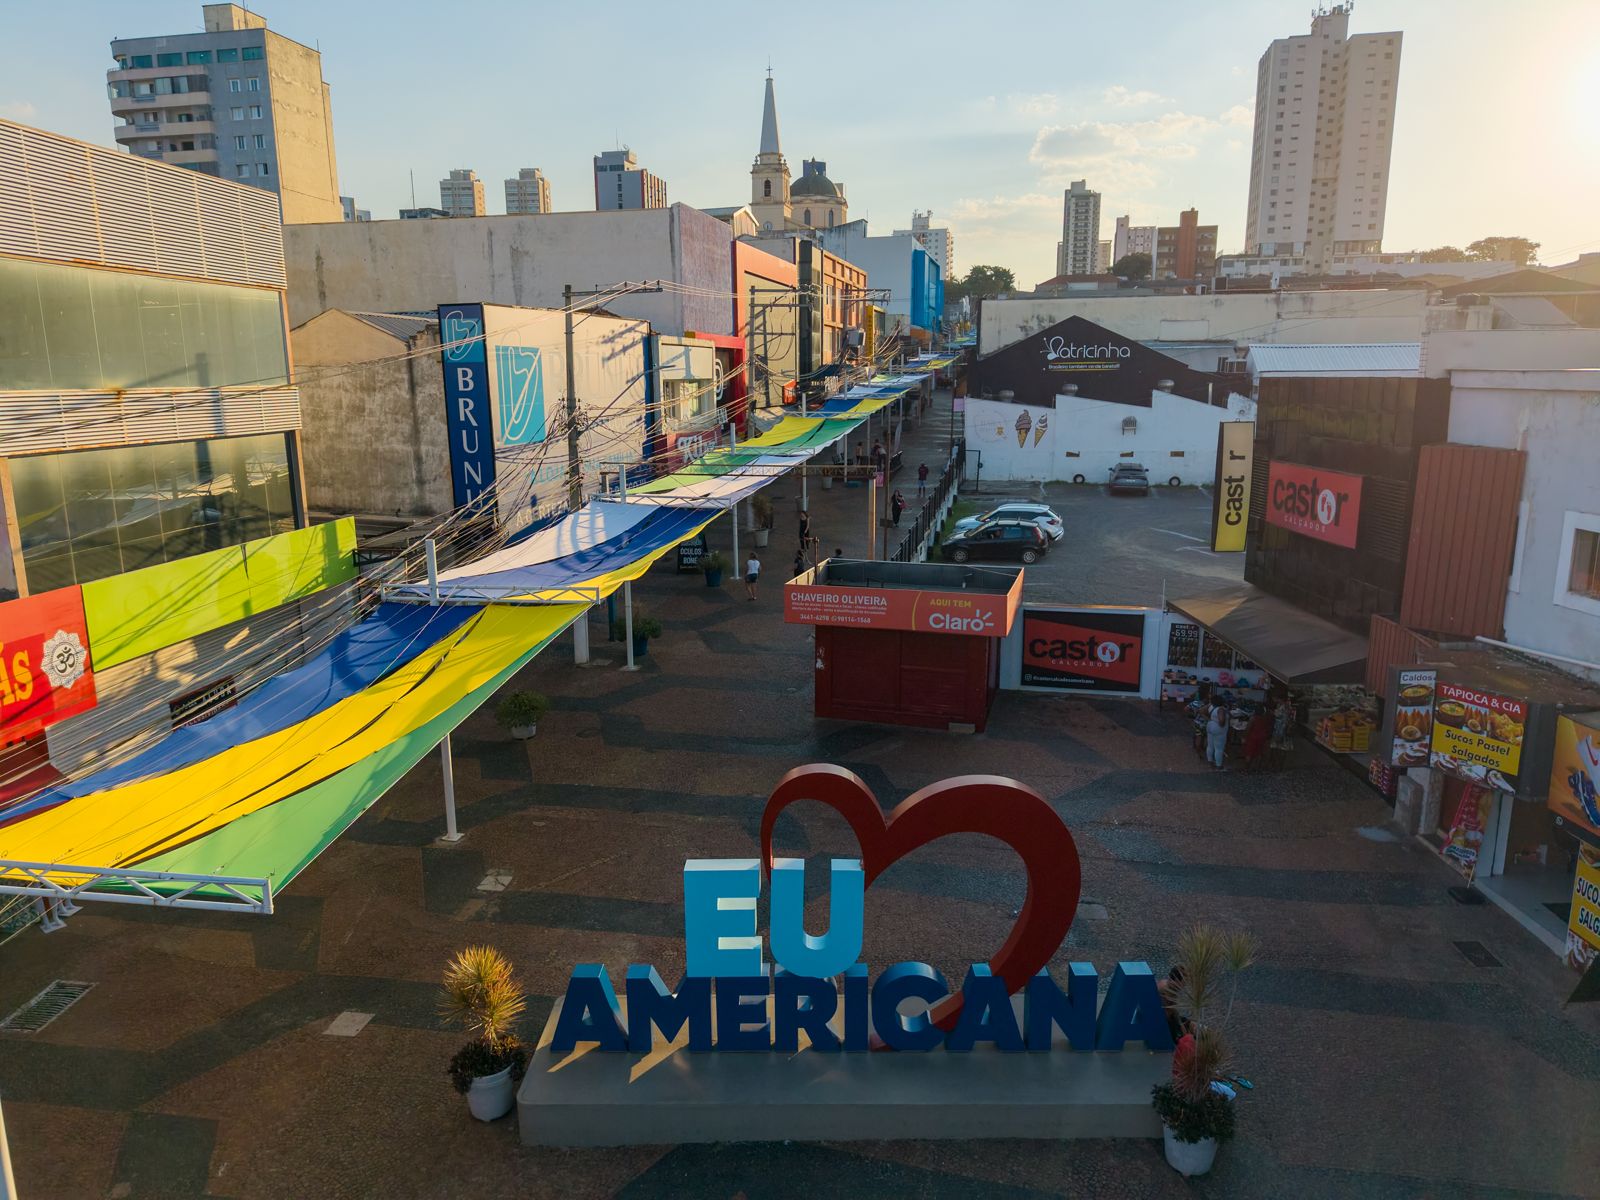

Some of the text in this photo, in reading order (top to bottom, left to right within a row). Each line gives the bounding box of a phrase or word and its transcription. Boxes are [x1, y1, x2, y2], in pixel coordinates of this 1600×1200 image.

[1047, 336, 1131, 360] Patricinha
[457, 367, 483, 512] BRUNU
[791, 592, 839, 604] CHAVEIRO
[842, 594, 887, 606] OLIVEIRA
[930, 598, 971, 608] AQUI TEM
[929, 612, 984, 632] Claro
[1029, 635, 1134, 663] castor
[1402, 673, 1432, 682] Caldos
[1441, 685, 1521, 714] TAPIOCA & CIA
[1445, 730, 1510, 756] Sucos Pastel
[1451, 745, 1500, 768] Salgados
[1576, 877, 1600, 907] SUCO
[684, 858, 865, 979] EU
[1579, 907, 1600, 937] SALG
[550, 961, 1175, 1053] AMERICANA
